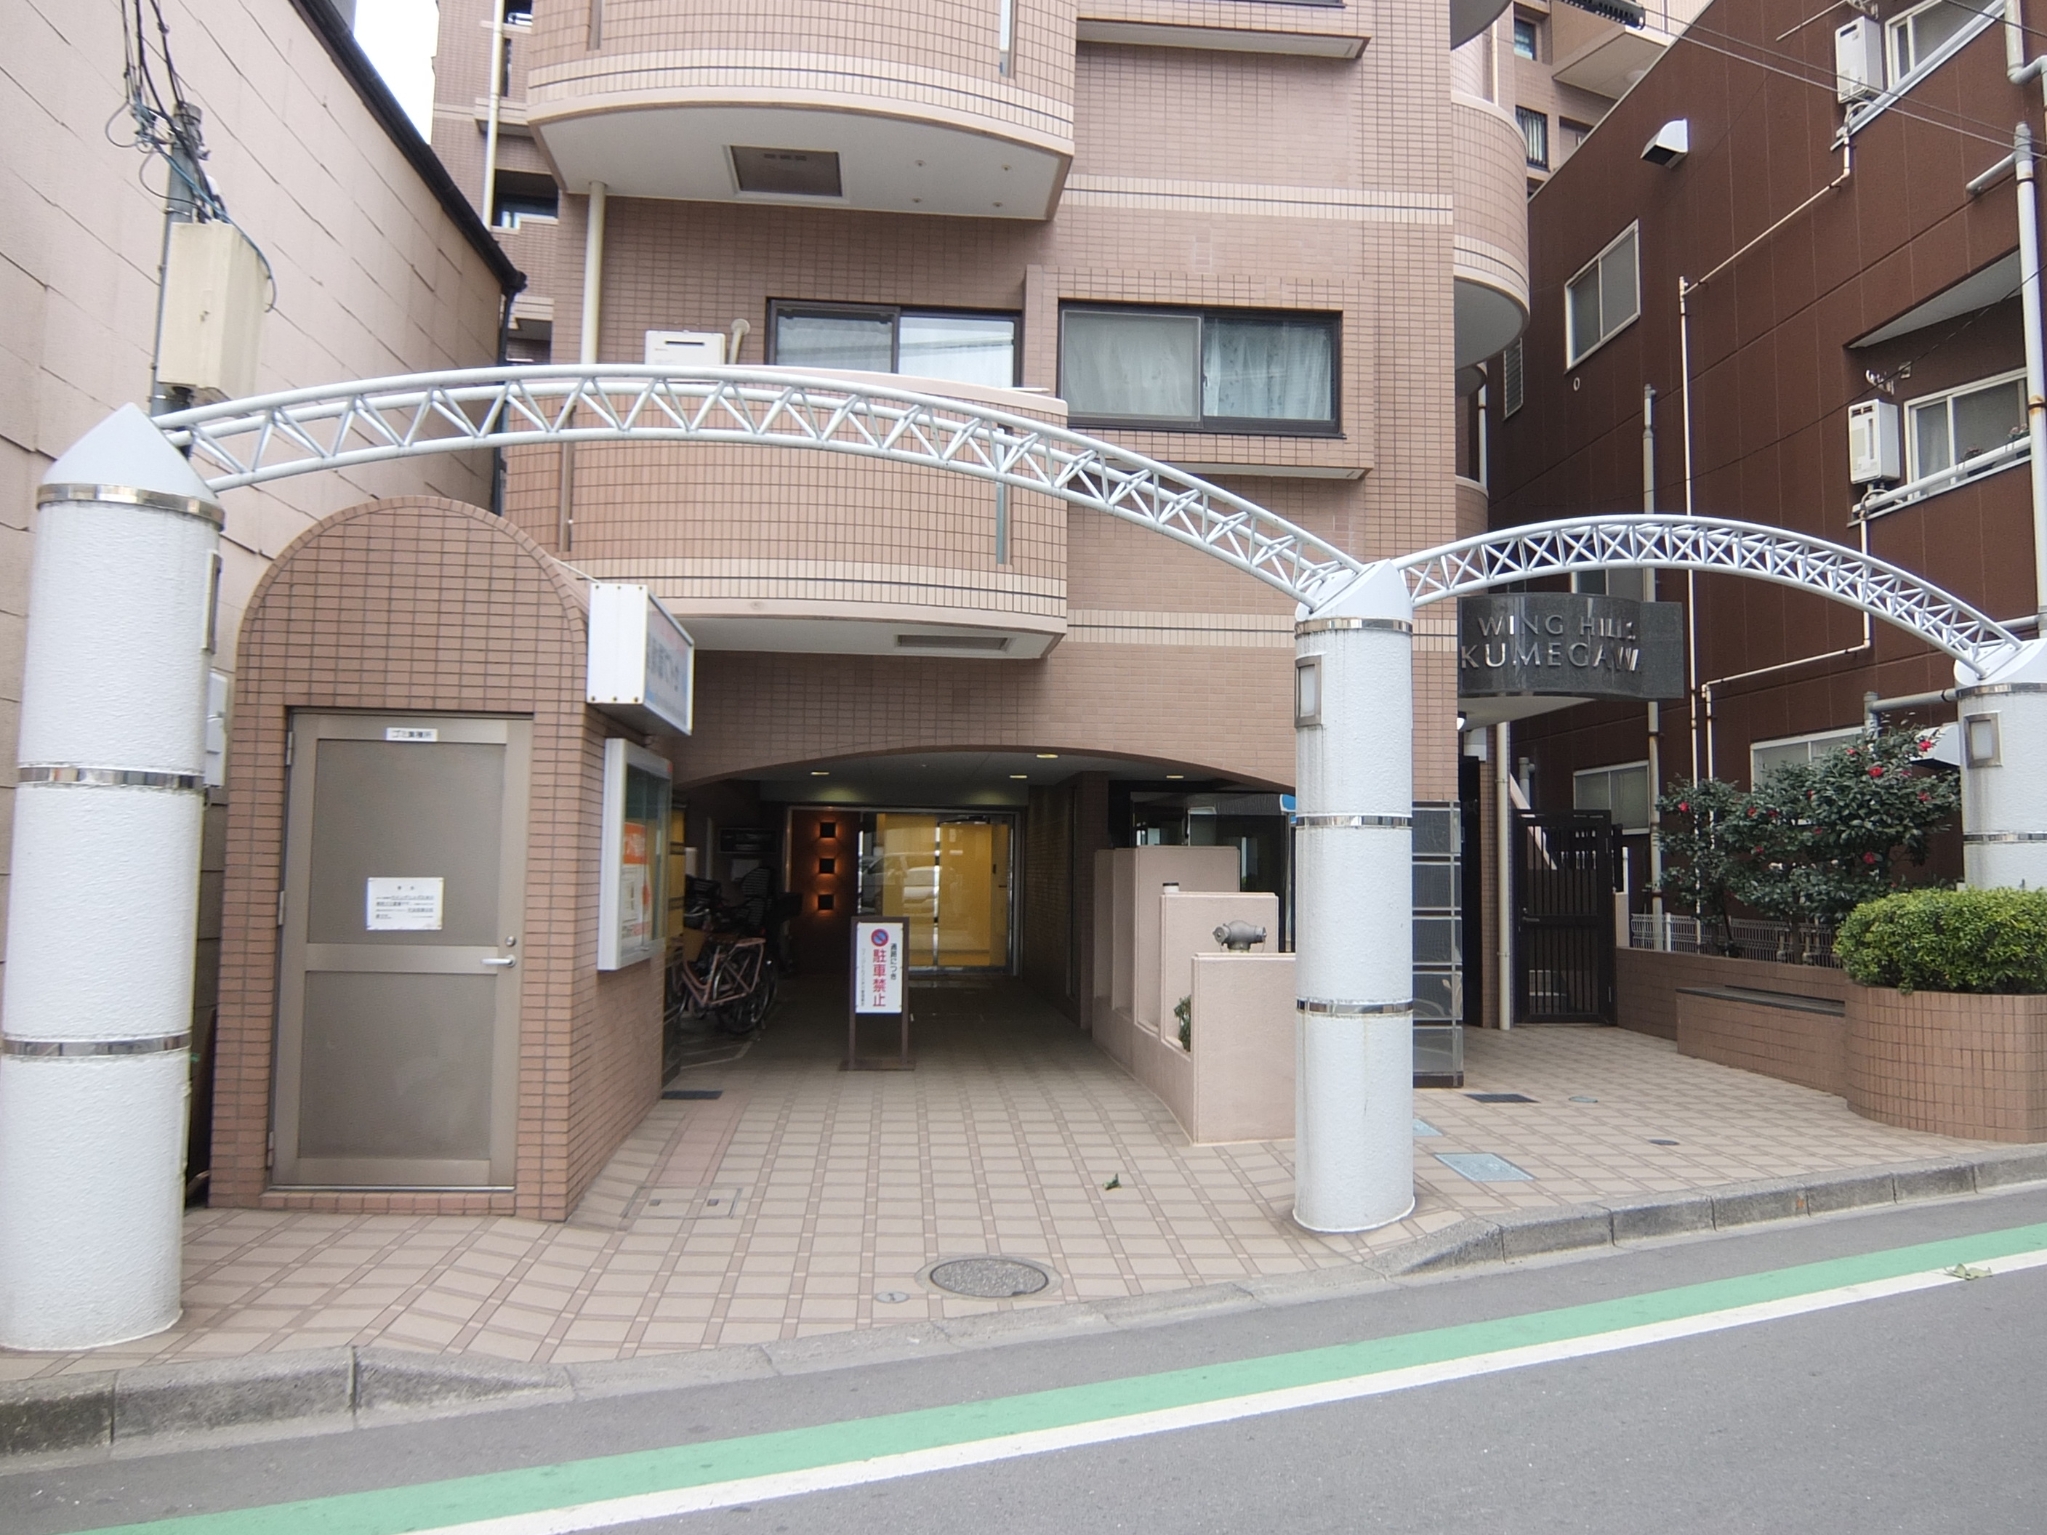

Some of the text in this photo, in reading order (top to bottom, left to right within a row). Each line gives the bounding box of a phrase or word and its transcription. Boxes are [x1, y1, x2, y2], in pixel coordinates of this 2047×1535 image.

[1478, 614, 1564, 637] WING
[872, 948, 887, 1007] 駐車禁止
